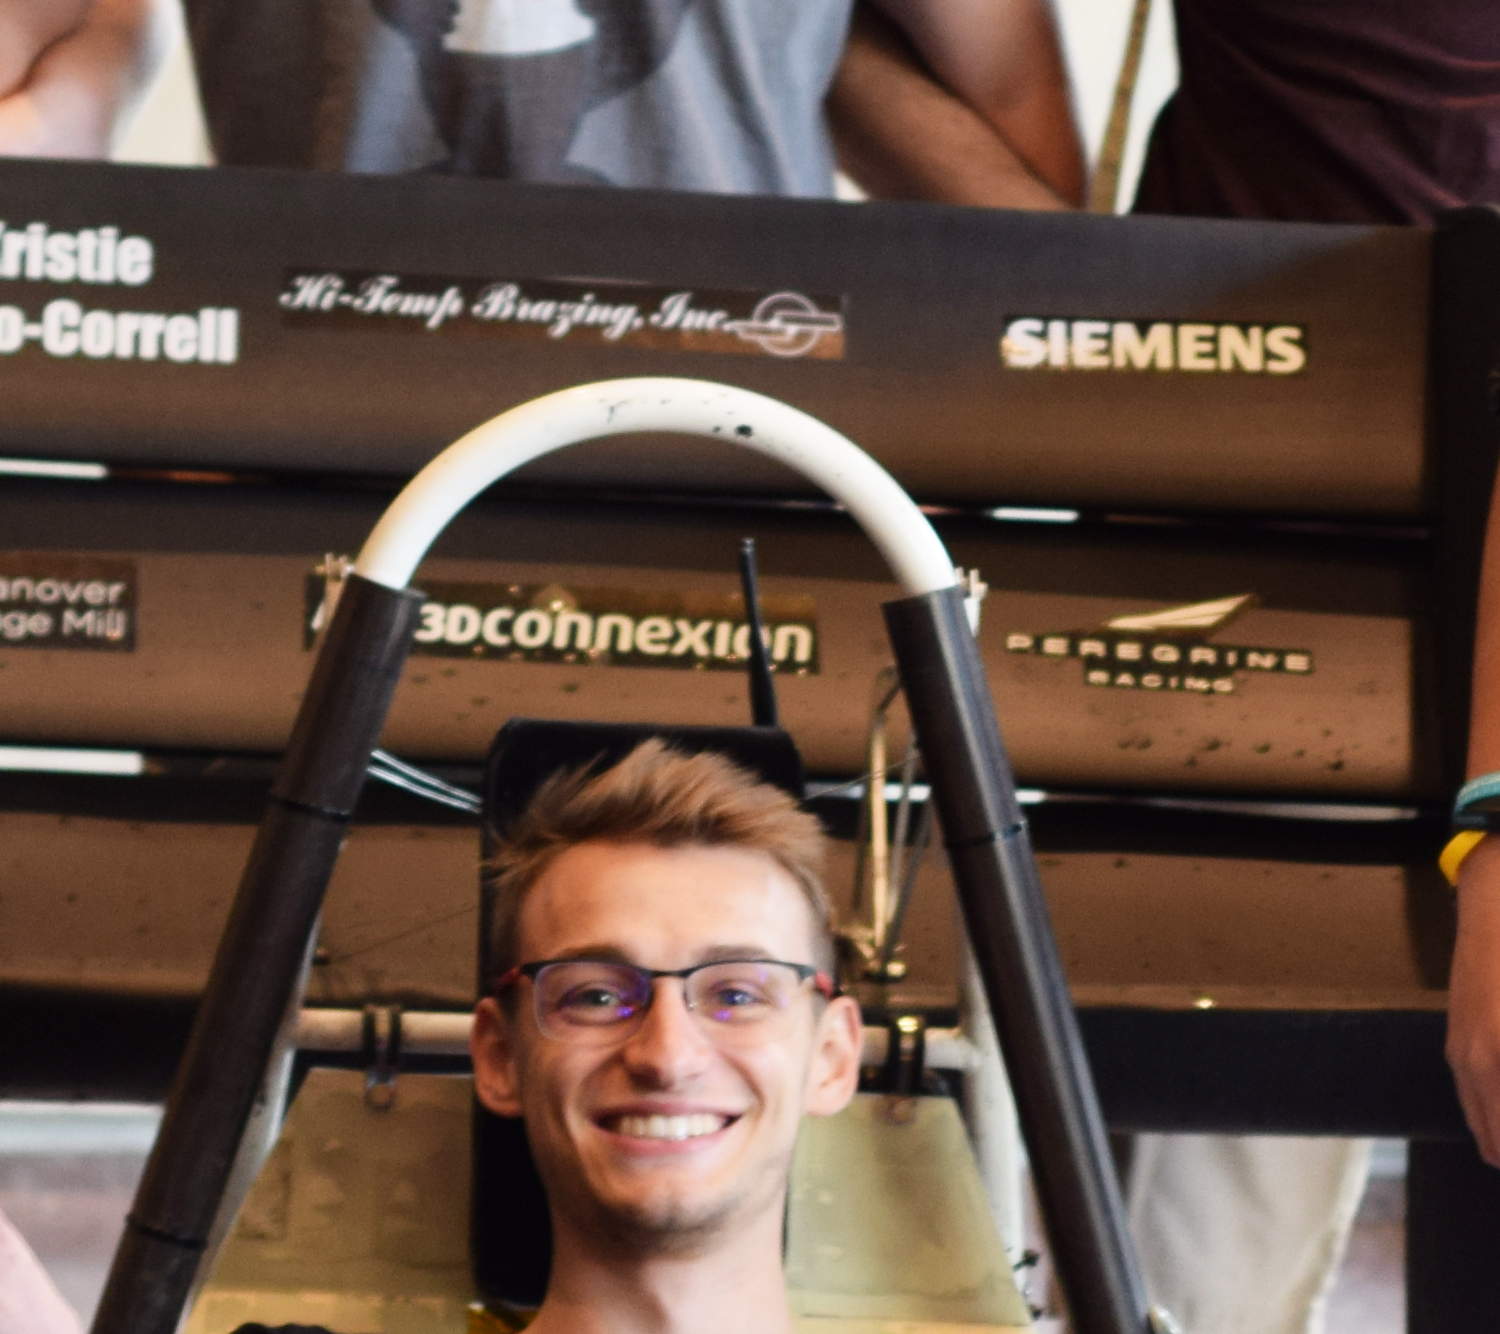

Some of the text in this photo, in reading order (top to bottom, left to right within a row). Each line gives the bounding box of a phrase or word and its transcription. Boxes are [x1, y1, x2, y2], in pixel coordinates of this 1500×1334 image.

[1003, 317, 1307, 374] SIEMENS
[61, 608, 126, 642] Mill
[1006, 632, 1311, 673] PEREGRINE
[1088, 669, 1234, 694] RACING
